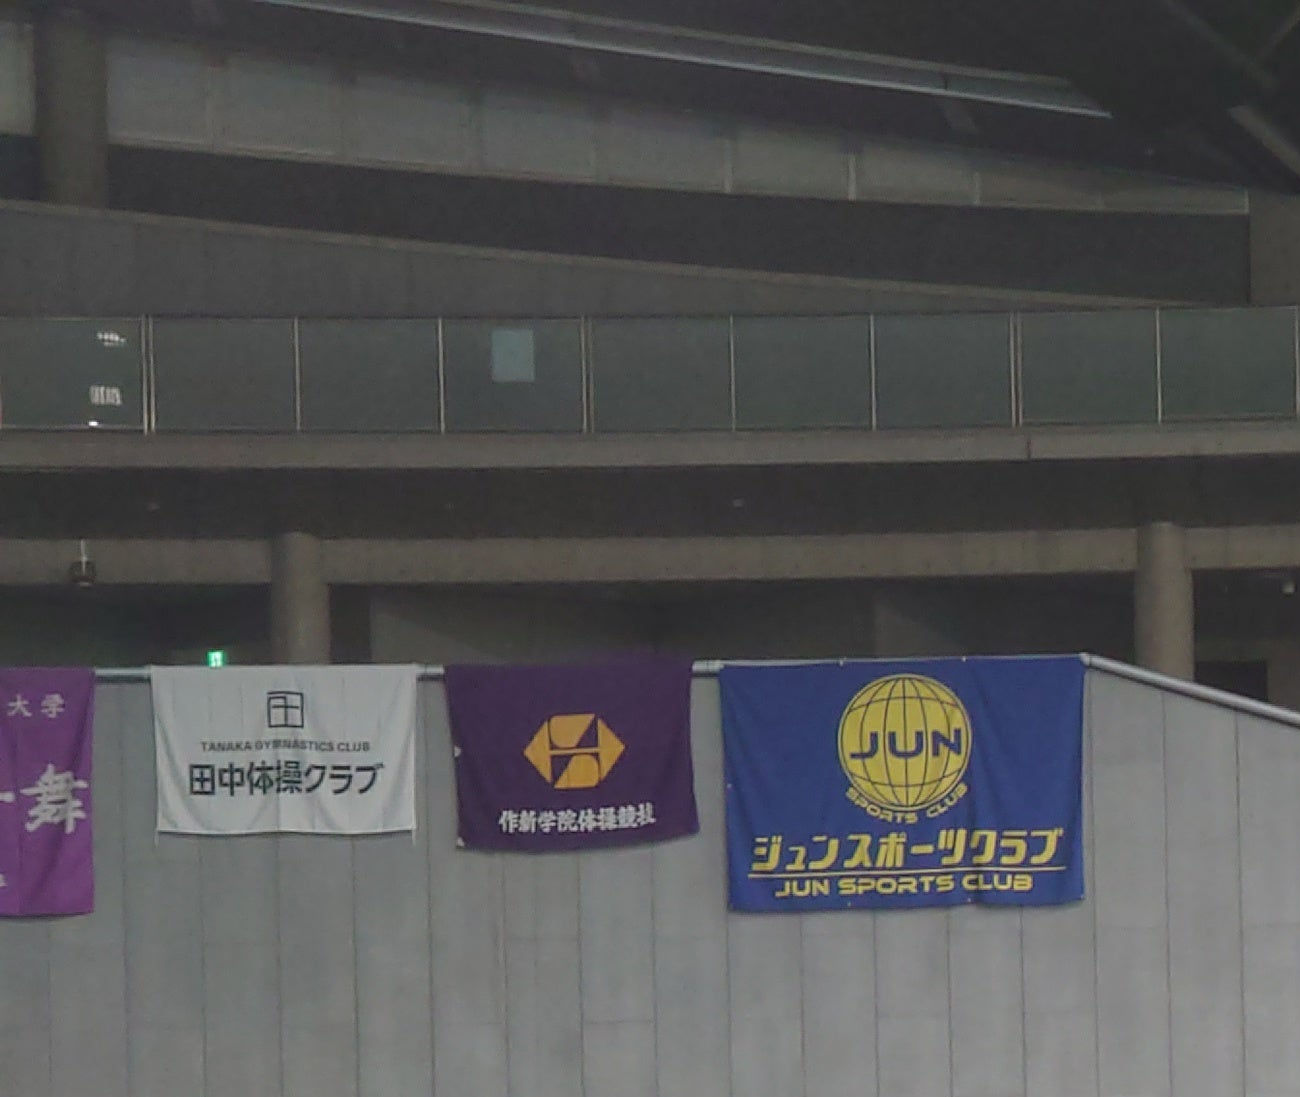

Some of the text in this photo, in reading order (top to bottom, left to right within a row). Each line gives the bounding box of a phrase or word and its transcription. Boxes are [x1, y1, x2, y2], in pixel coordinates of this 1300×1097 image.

[201, 738, 371, 752] TANAKA GYMNASTICS CLUB
[850, 727, 963, 759] JUN
[189, 759, 385, 797] 田中体操クラブ
[846, 782, 968, 824] SPORTS CLUB
[751, 828, 1064, 872] ジュンスポーツクラブ
[775, 873, 1034, 897] JUN SPORTS CLUB
